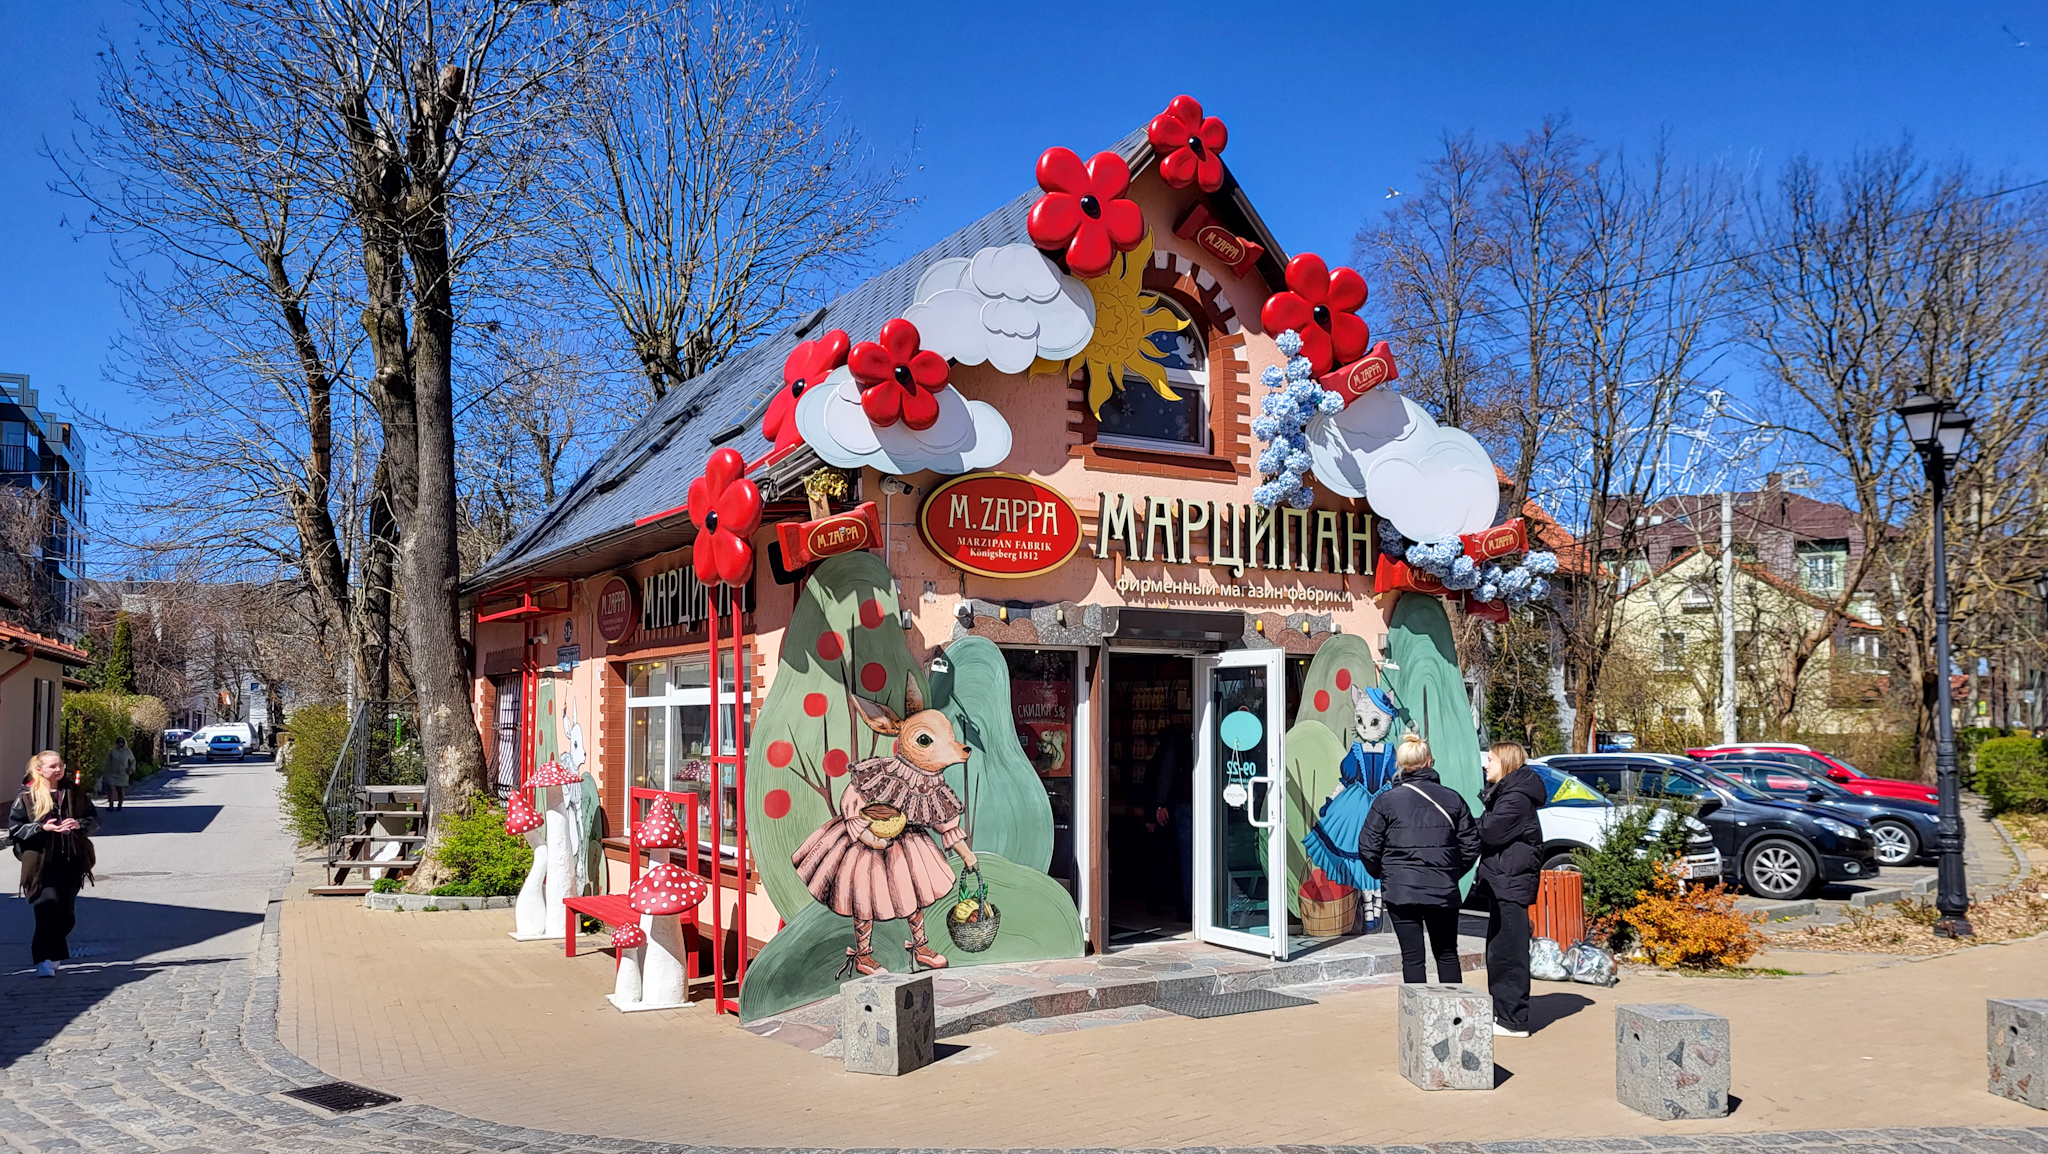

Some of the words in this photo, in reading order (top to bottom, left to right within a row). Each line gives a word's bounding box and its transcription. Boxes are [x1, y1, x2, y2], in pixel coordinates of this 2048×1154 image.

[1096, 491, 1373, 578] МАРЦИПАН
[957, 536, 1012, 549] MARZIPAN
[1015, 540, 1052, 552] FABRIK
[970, 548, 1017, 562] Königsberg
[1018, 551, 1039, 561] 1812
[1220, 582, 1284, 600] магазин
[1287, 584, 1352, 603] фабрики
[1017, 703, 1053, 719] СКИДКА
[1054, 704, 1066, 719] 5%
